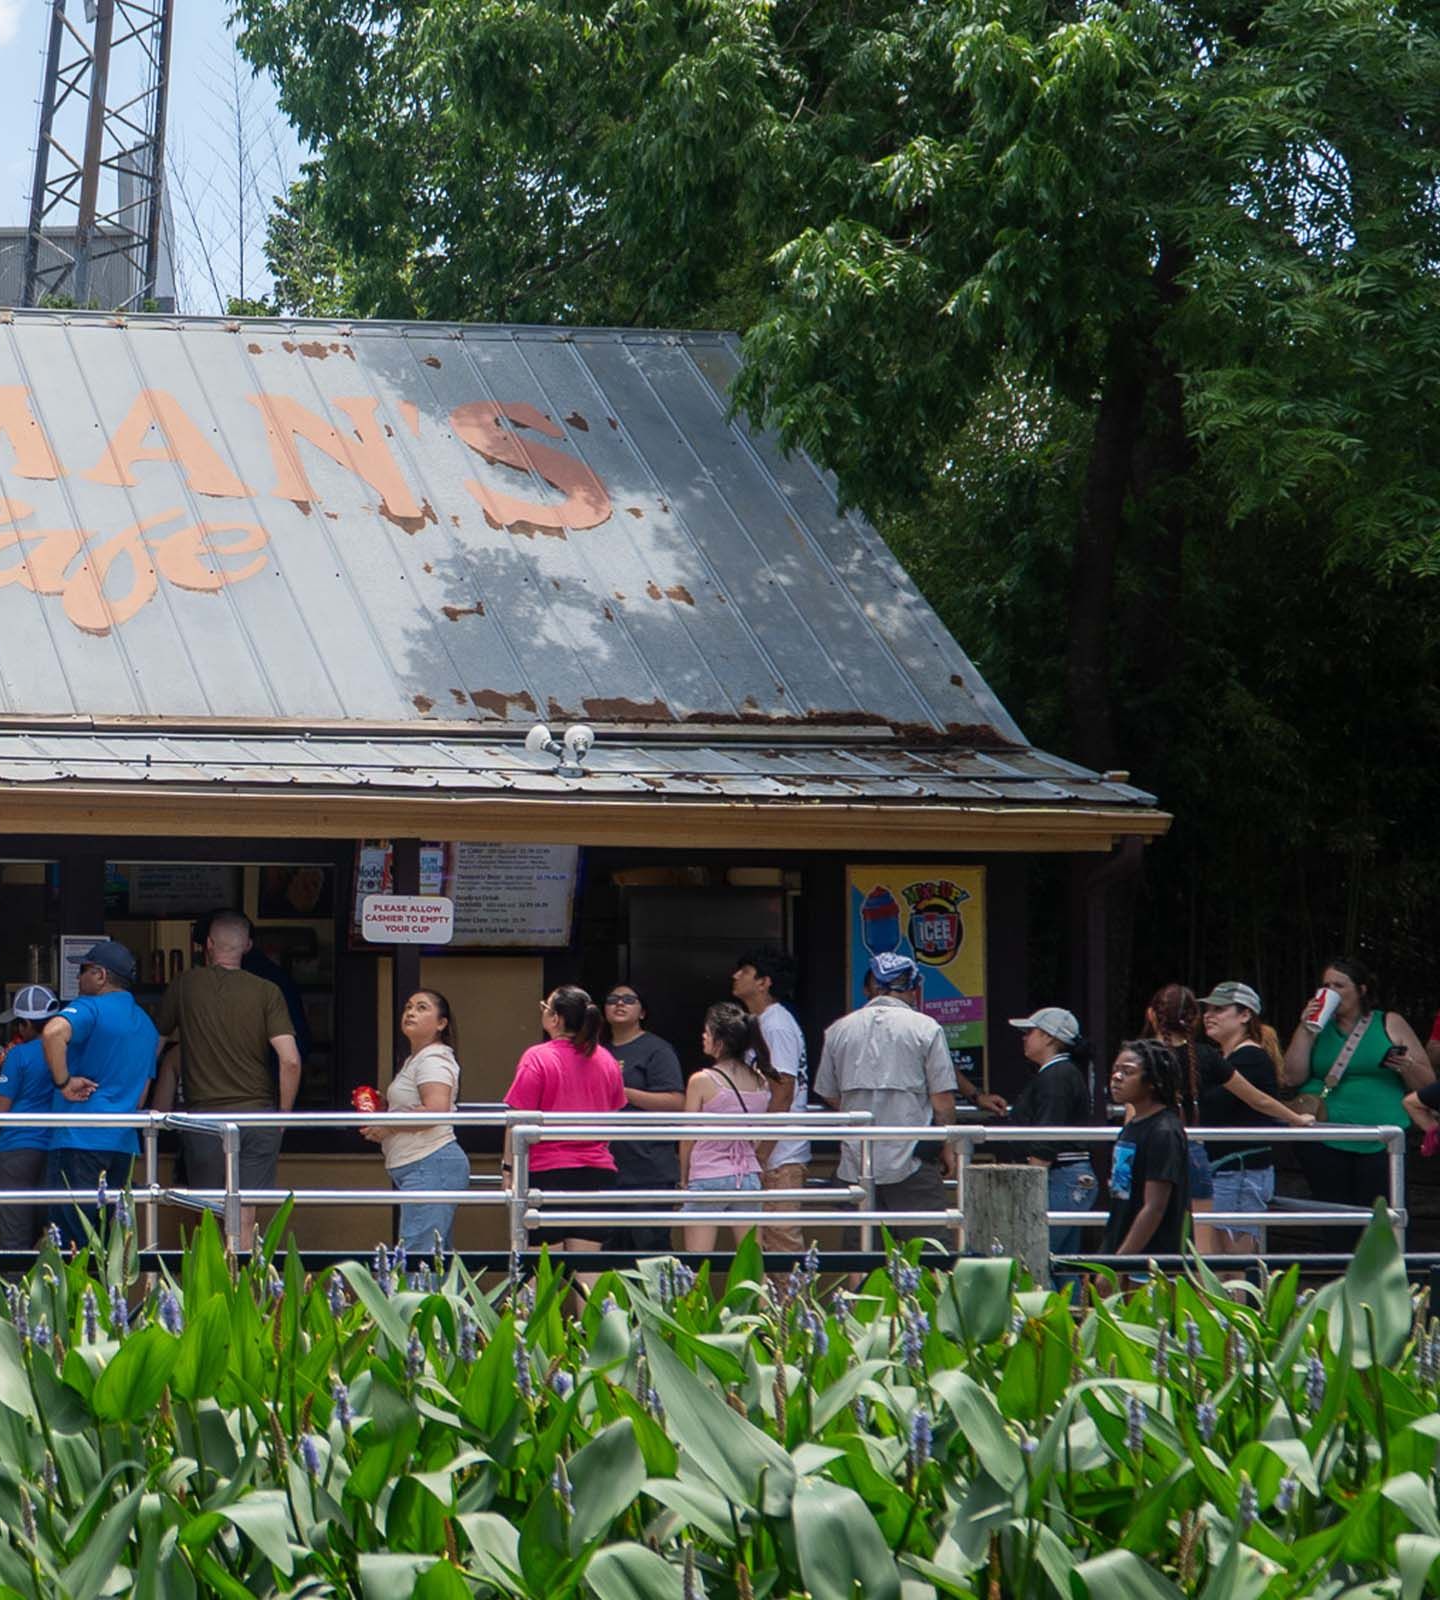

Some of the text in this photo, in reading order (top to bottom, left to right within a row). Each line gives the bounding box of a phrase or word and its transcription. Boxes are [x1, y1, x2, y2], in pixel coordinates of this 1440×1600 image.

[374, 904, 442, 913] PLEASE ALLOW
[365, 914, 450, 924] CASHIER TO EMPTY
[412, 925, 431, 933] CUP
[917, 920, 952, 941] ICEE
